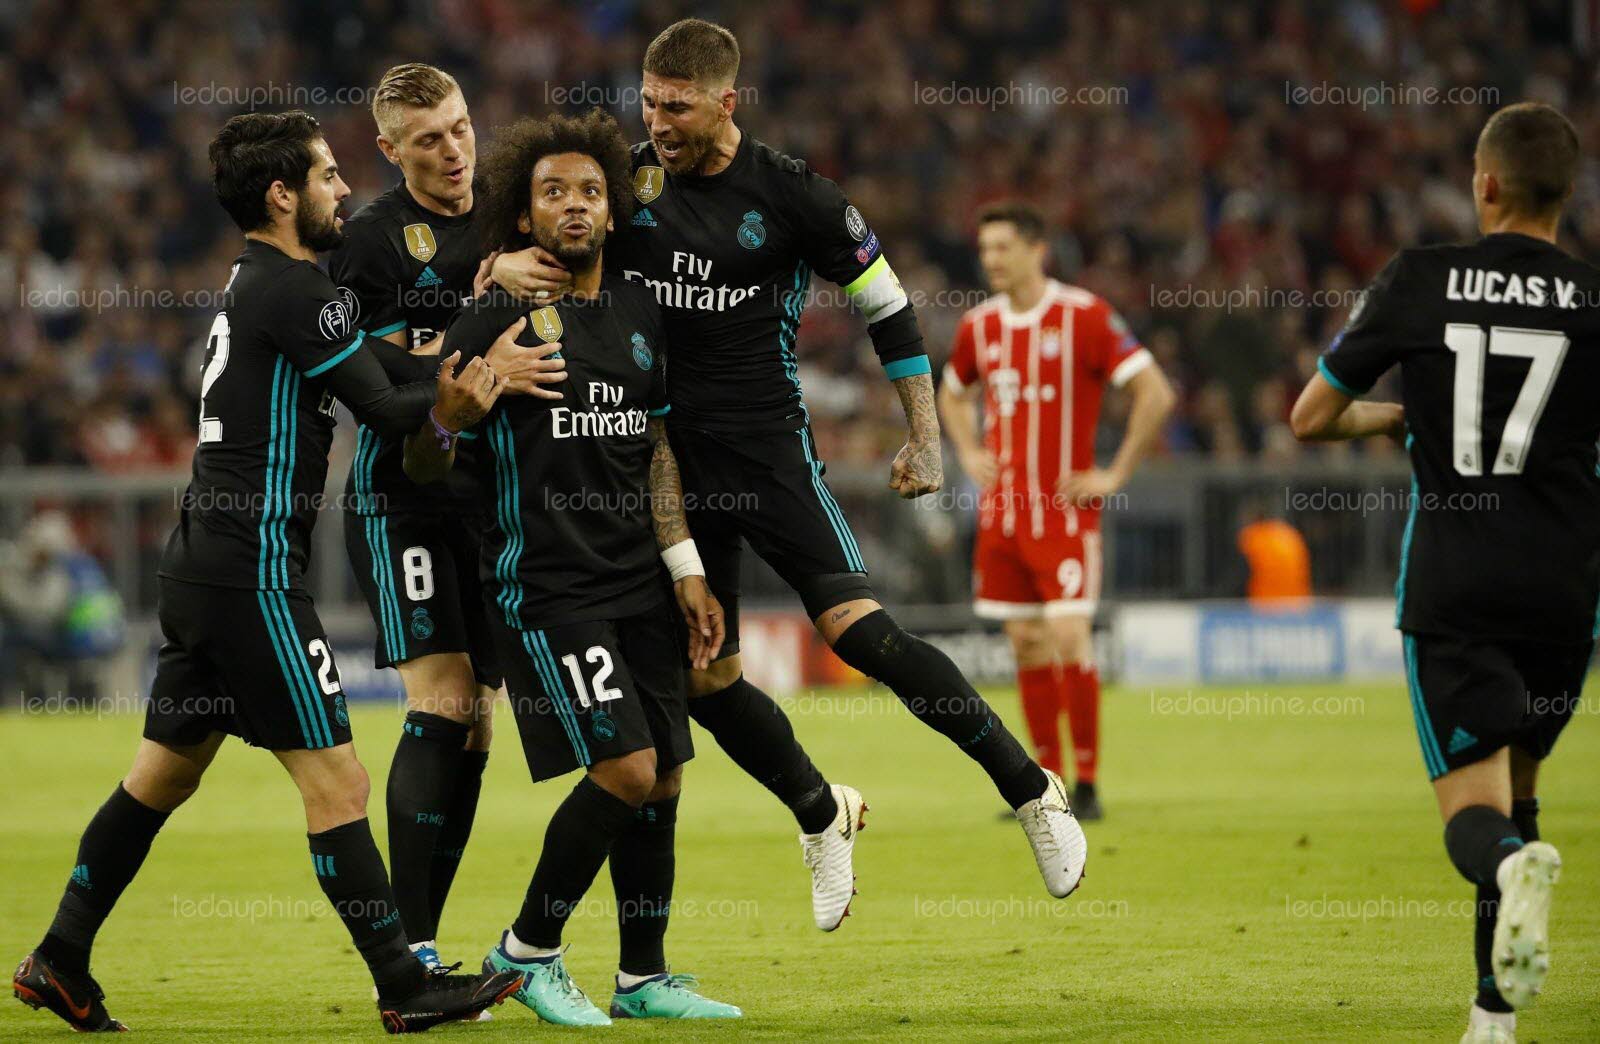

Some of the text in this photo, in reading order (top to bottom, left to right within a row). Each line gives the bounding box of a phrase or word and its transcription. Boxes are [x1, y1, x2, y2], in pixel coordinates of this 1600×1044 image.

[631, 217, 658, 228] adidas
[415, 277, 443, 288] adidas
[672, 250, 713, 282] Fly
[1446, 267, 1577, 310] LUCAS V.
[197, 311, 230, 448] 2
[588, 381, 624, 408] Fly
[1444, 322, 1571, 477] 17
[550, 404, 649, 439] Emirates
[402, 546, 435, 601] 8
[1056, 557, 1082, 599] 9
[308, 638, 342, 696] 2
[561, 645, 623, 708] 12
